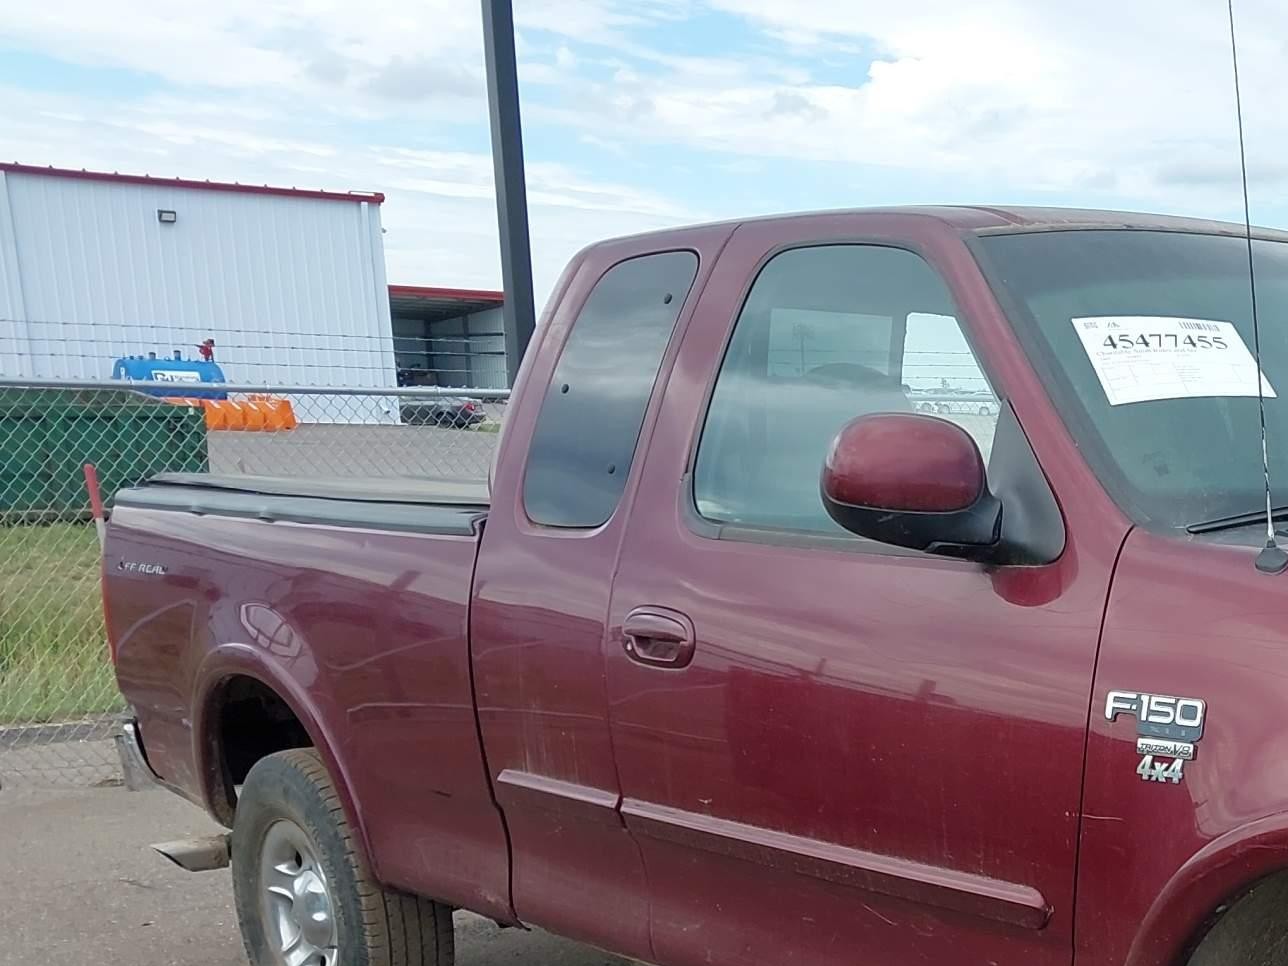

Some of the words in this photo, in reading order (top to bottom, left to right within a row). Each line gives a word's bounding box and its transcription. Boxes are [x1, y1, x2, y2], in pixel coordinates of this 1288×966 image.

[1103, 333, 1229, 350] 45477455
[1104, 691, 1204, 727] F-150
[1139, 743, 1172, 755] TRITON
[1173, 744, 1192, 757] V8
[1137, 755, 1185, 785] 4x4
